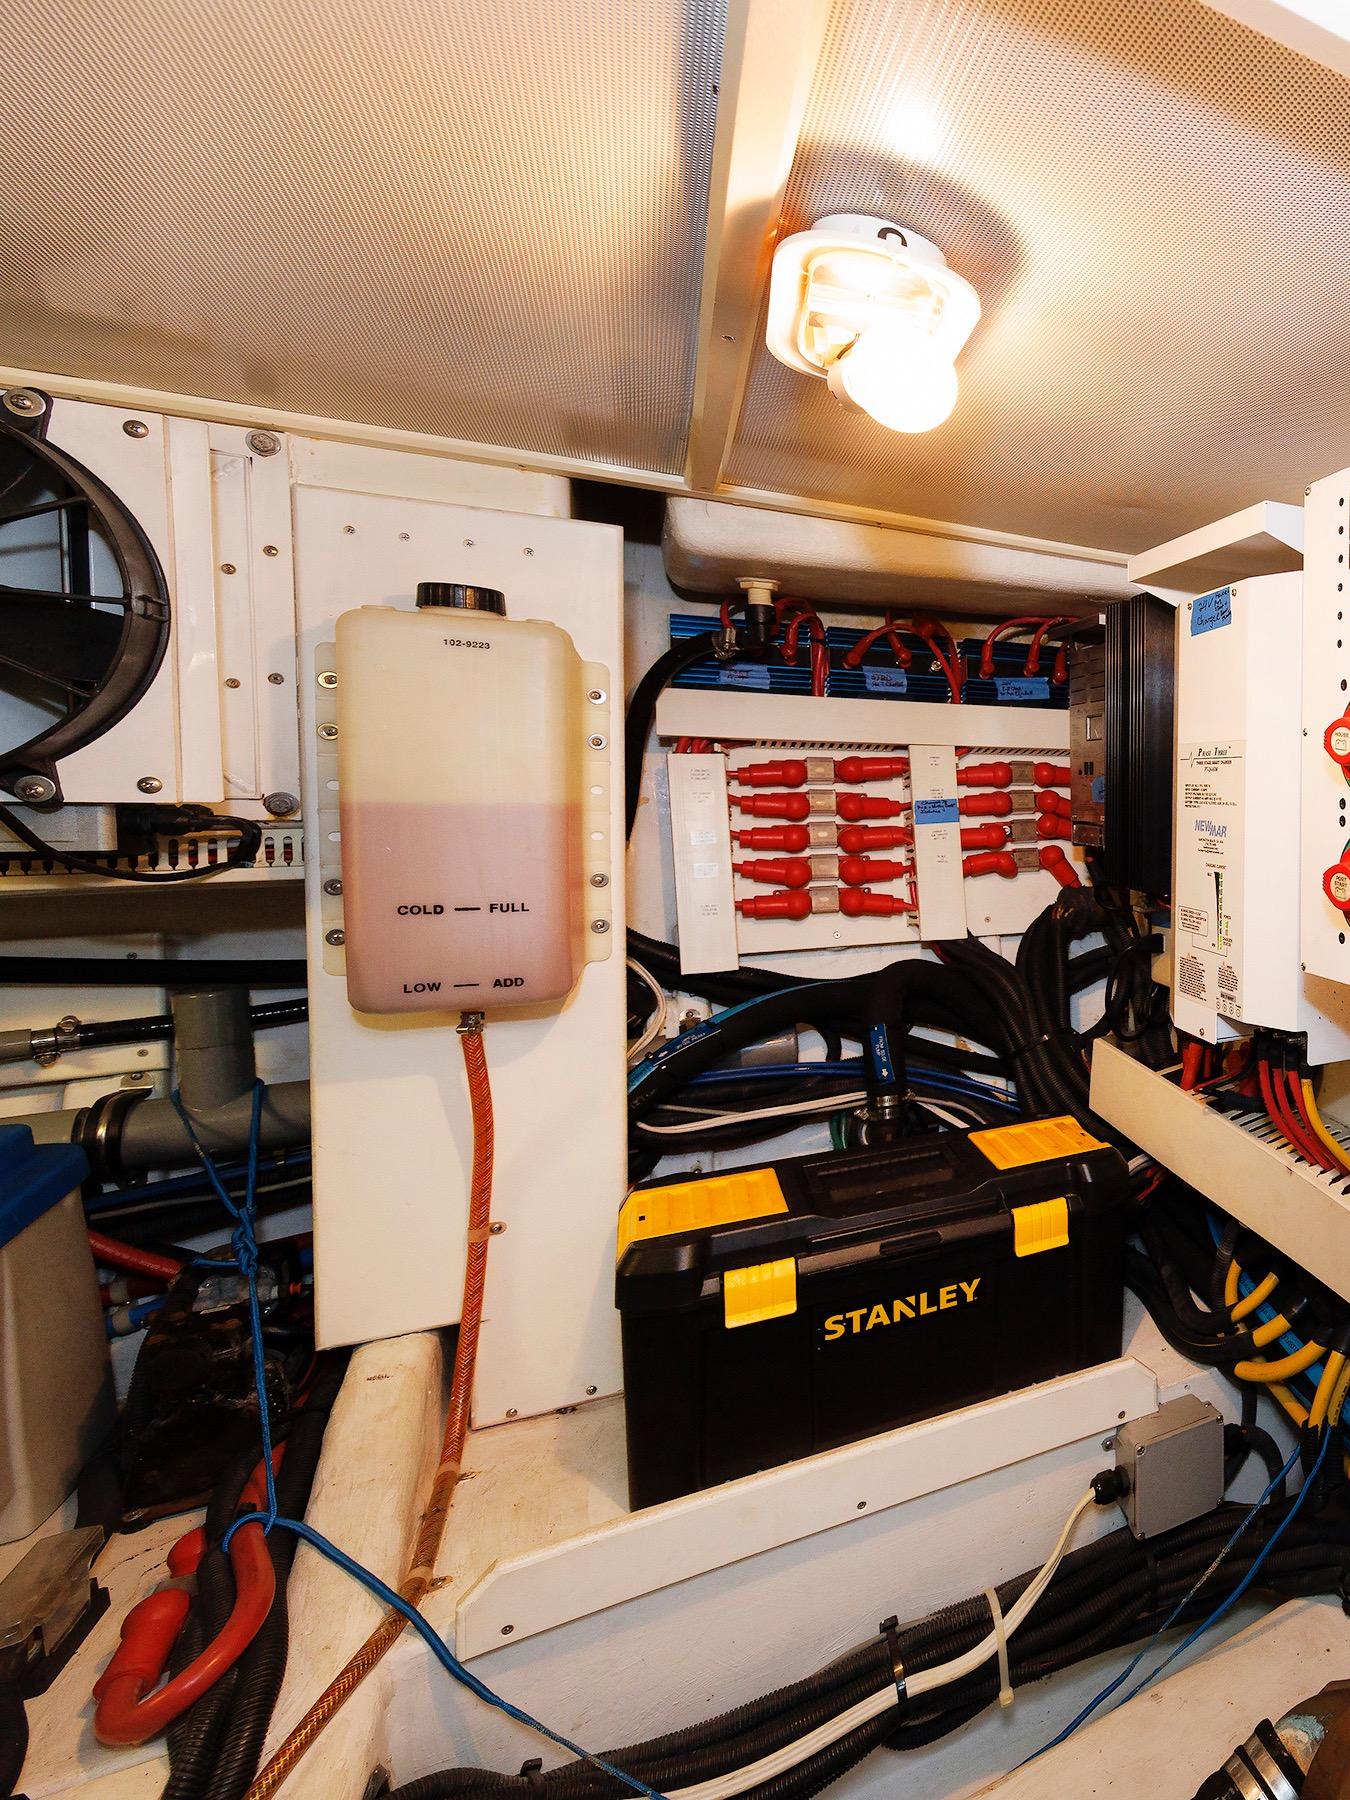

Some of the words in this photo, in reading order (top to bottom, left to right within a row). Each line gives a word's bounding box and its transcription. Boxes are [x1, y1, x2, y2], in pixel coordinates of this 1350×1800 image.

[443, 639, 490, 650] 102-9223
[397, 904, 444, 916] COLD
[489, 902, 530, 914] FULL
[403, 982, 442, 994] LOW
[492, 977, 525, 989] ADD
[824, 1277, 982, 1341] STANLEY
